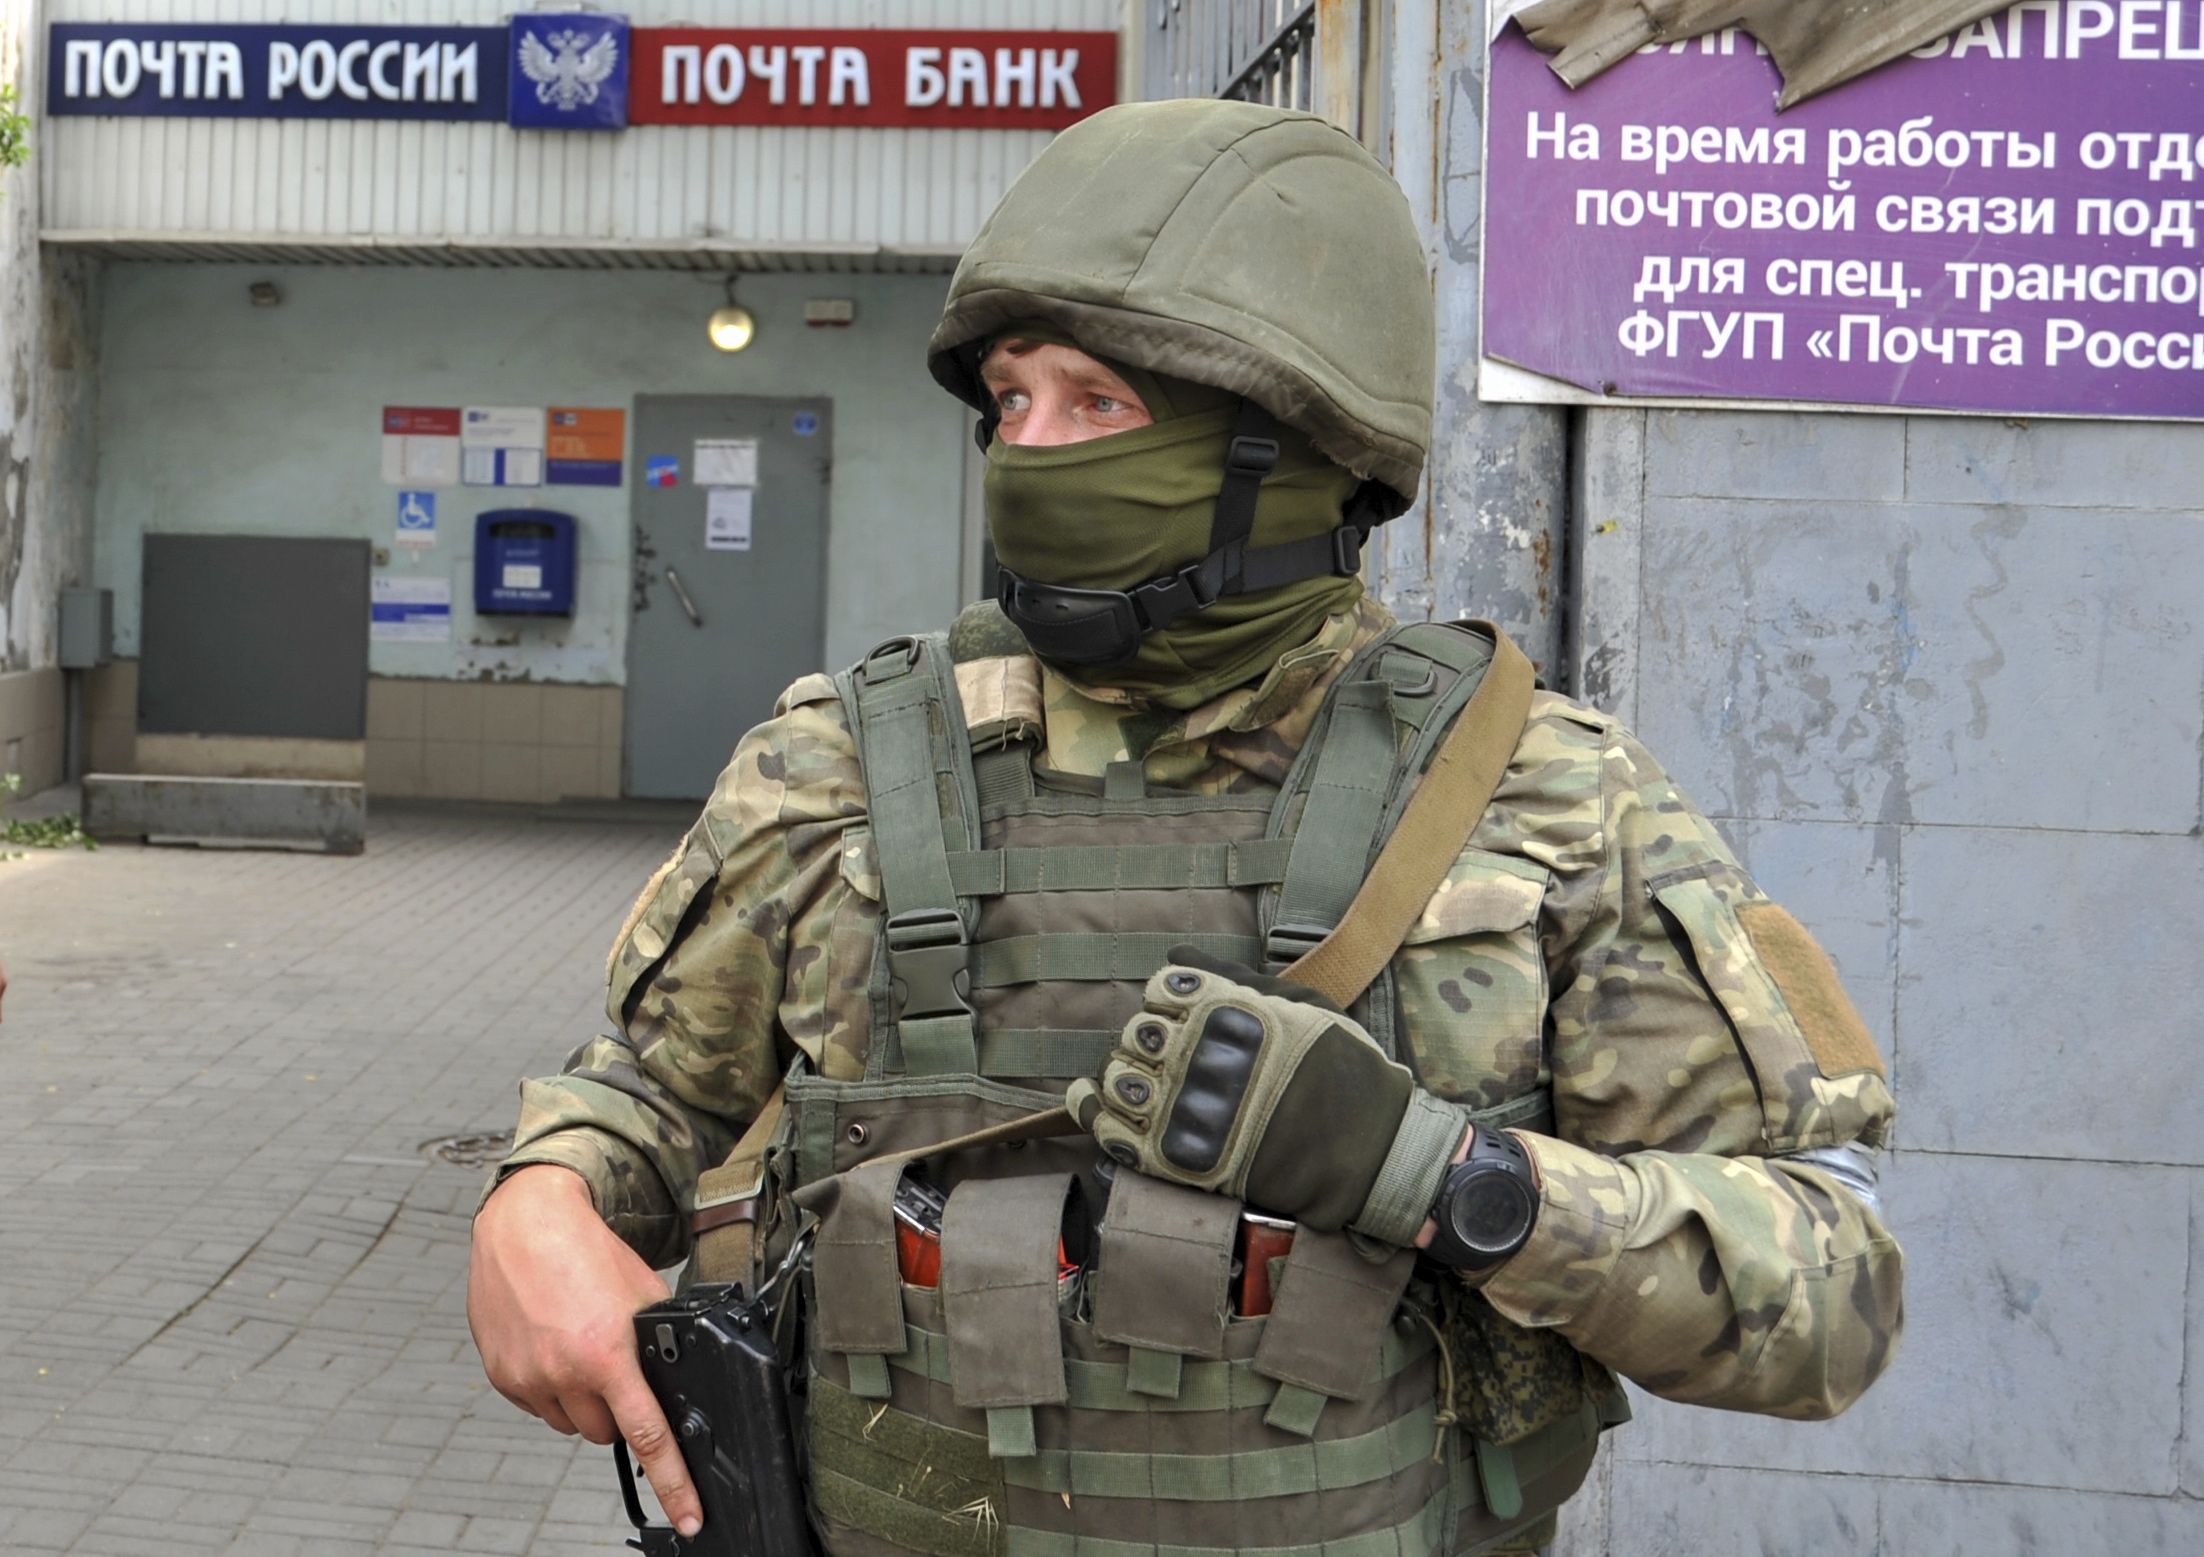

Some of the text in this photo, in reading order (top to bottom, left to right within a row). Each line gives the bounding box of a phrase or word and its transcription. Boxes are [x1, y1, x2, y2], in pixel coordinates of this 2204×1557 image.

[64, 39, 478, 102] ПОЧТА РОССИИ
[661, 43, 1081, 107] ПОЧТА БАНК
[1526, 111, 1600, 160] На
[1620, 124, 1806, 175] время
[1827, 115, 2056, 178] работы
[1575, 179, 2204, 248] почтовой связи под
[1633, 256, 2204, 317] для спец. транспо
[1618, 310, 1784, 360] ФГУП
[1806, 313, 2023, 366] «Почта
